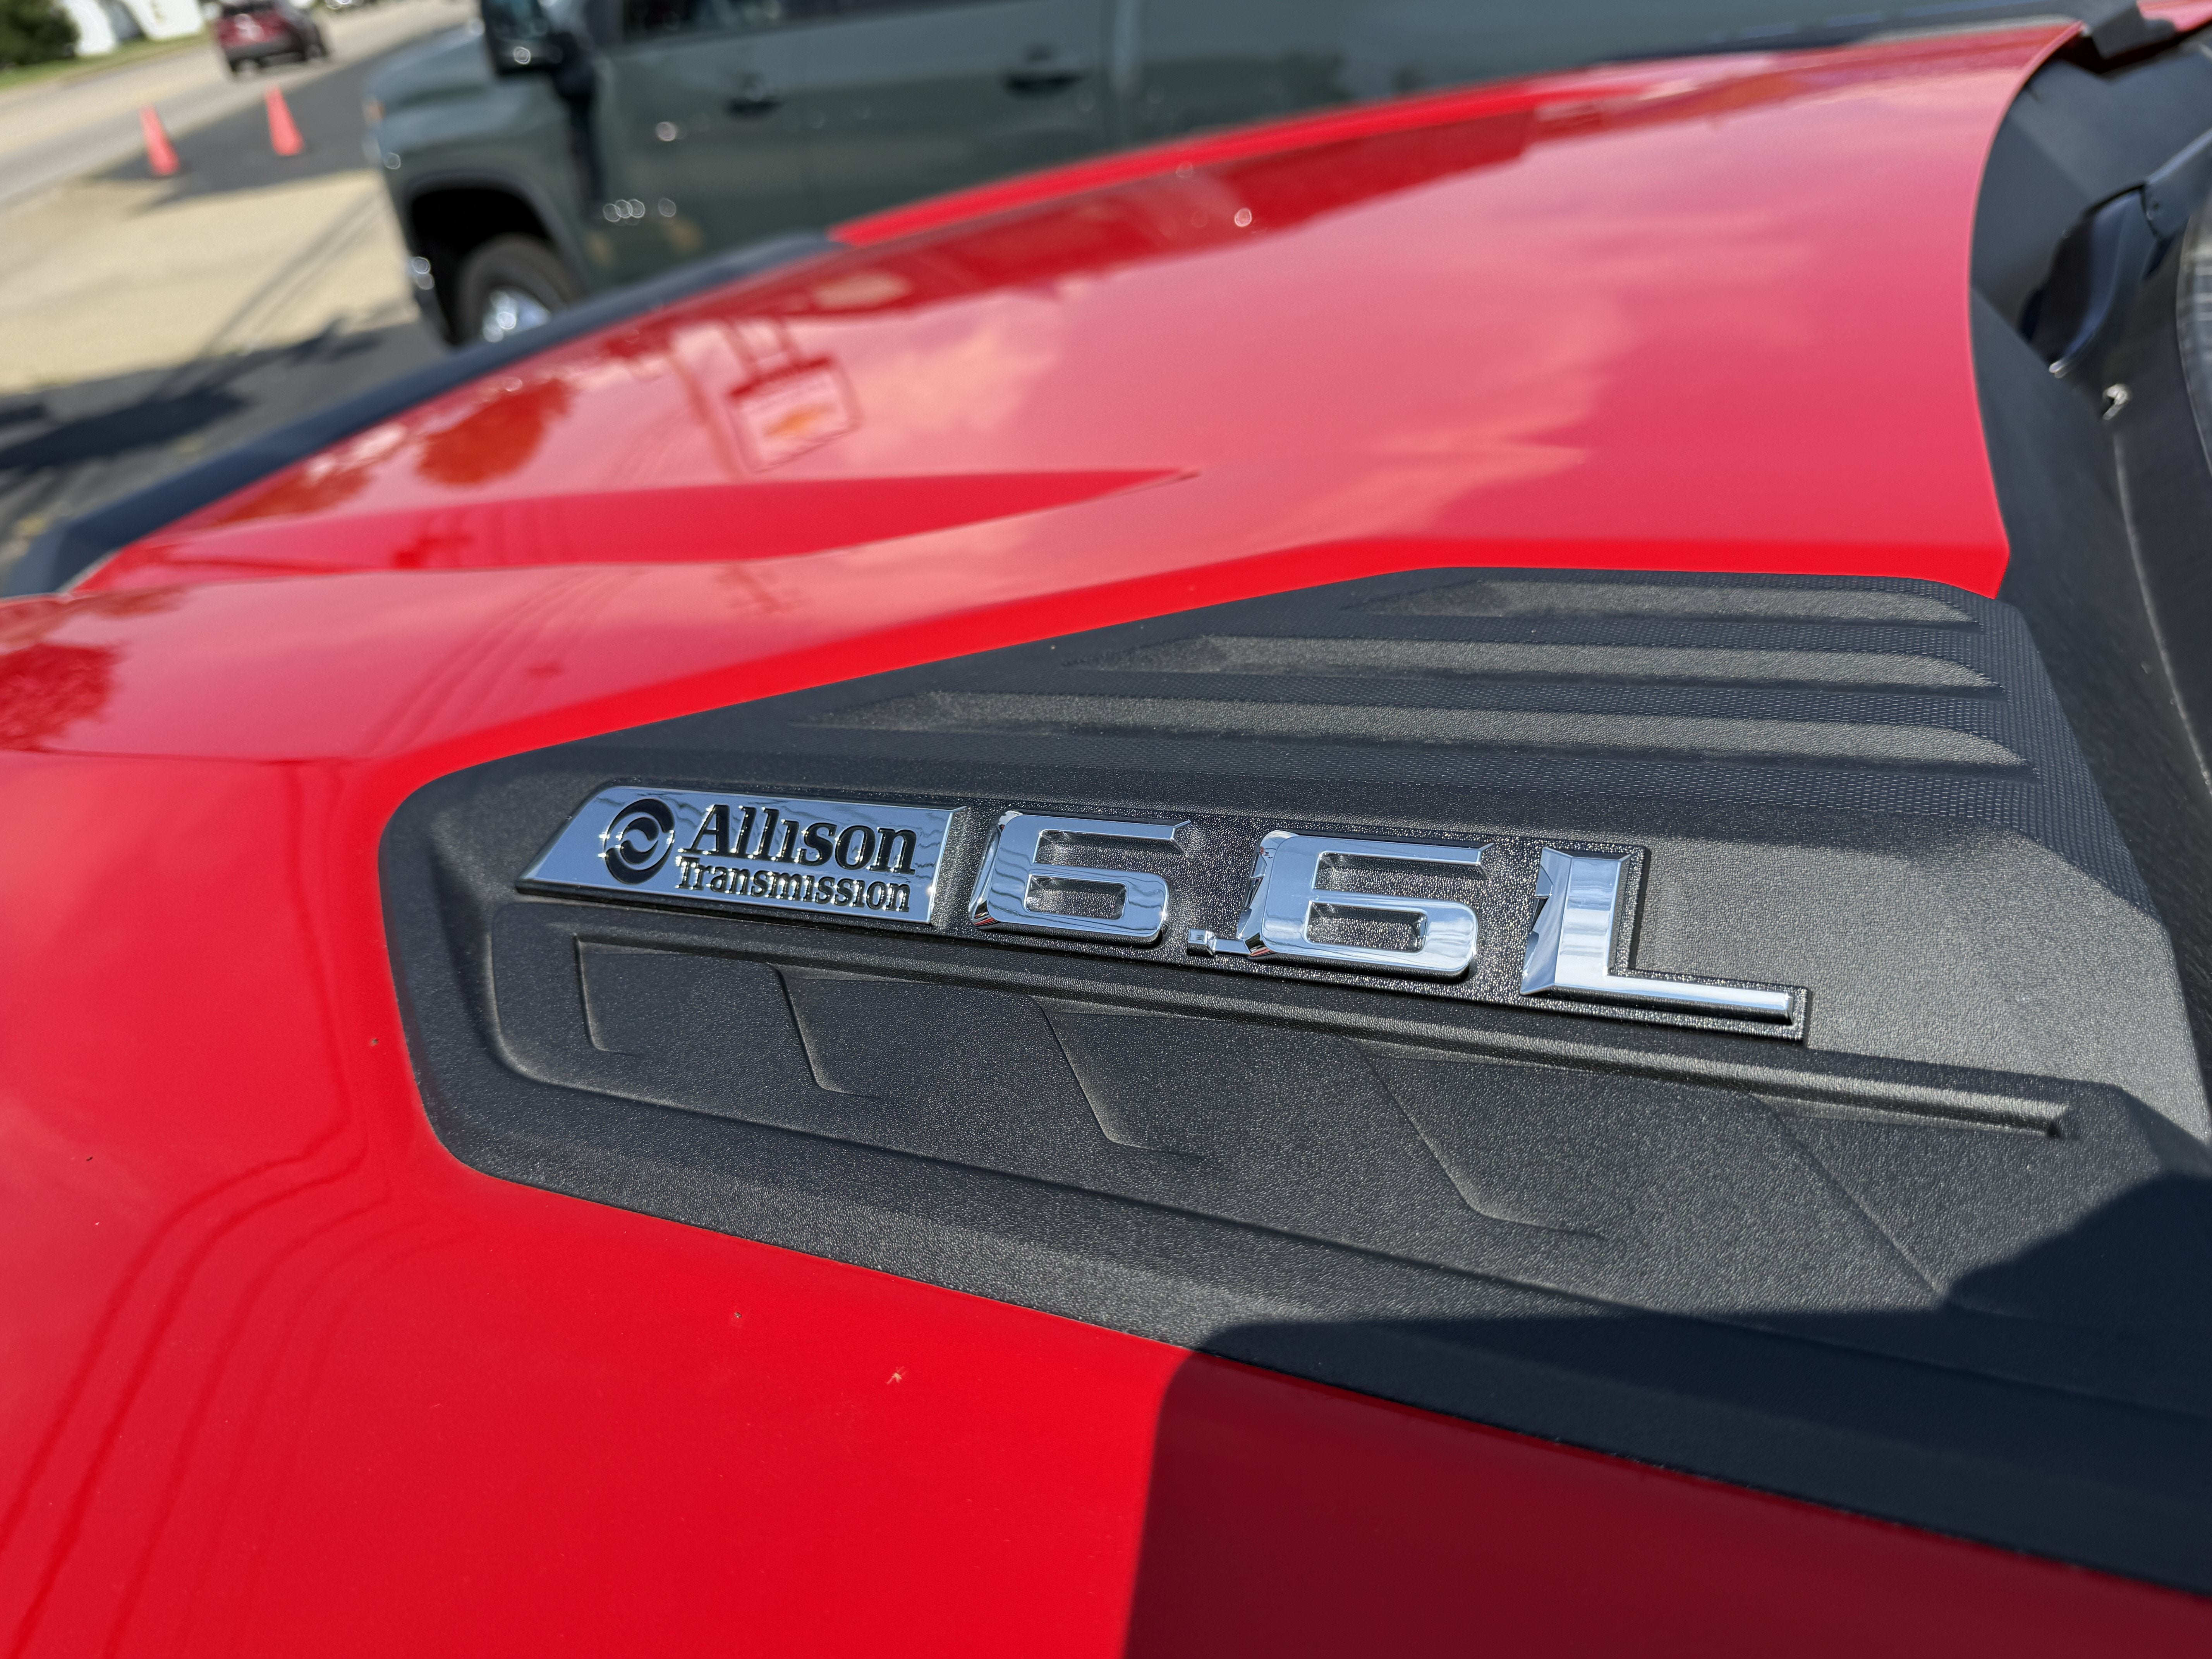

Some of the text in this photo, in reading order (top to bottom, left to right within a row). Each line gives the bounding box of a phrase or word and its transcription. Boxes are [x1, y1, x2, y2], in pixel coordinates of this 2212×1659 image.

[679, 804, 916, 874] Allison
[675, 855, 910, 912] Transmission
[969, 809, 1795, 1025] 6.6L
